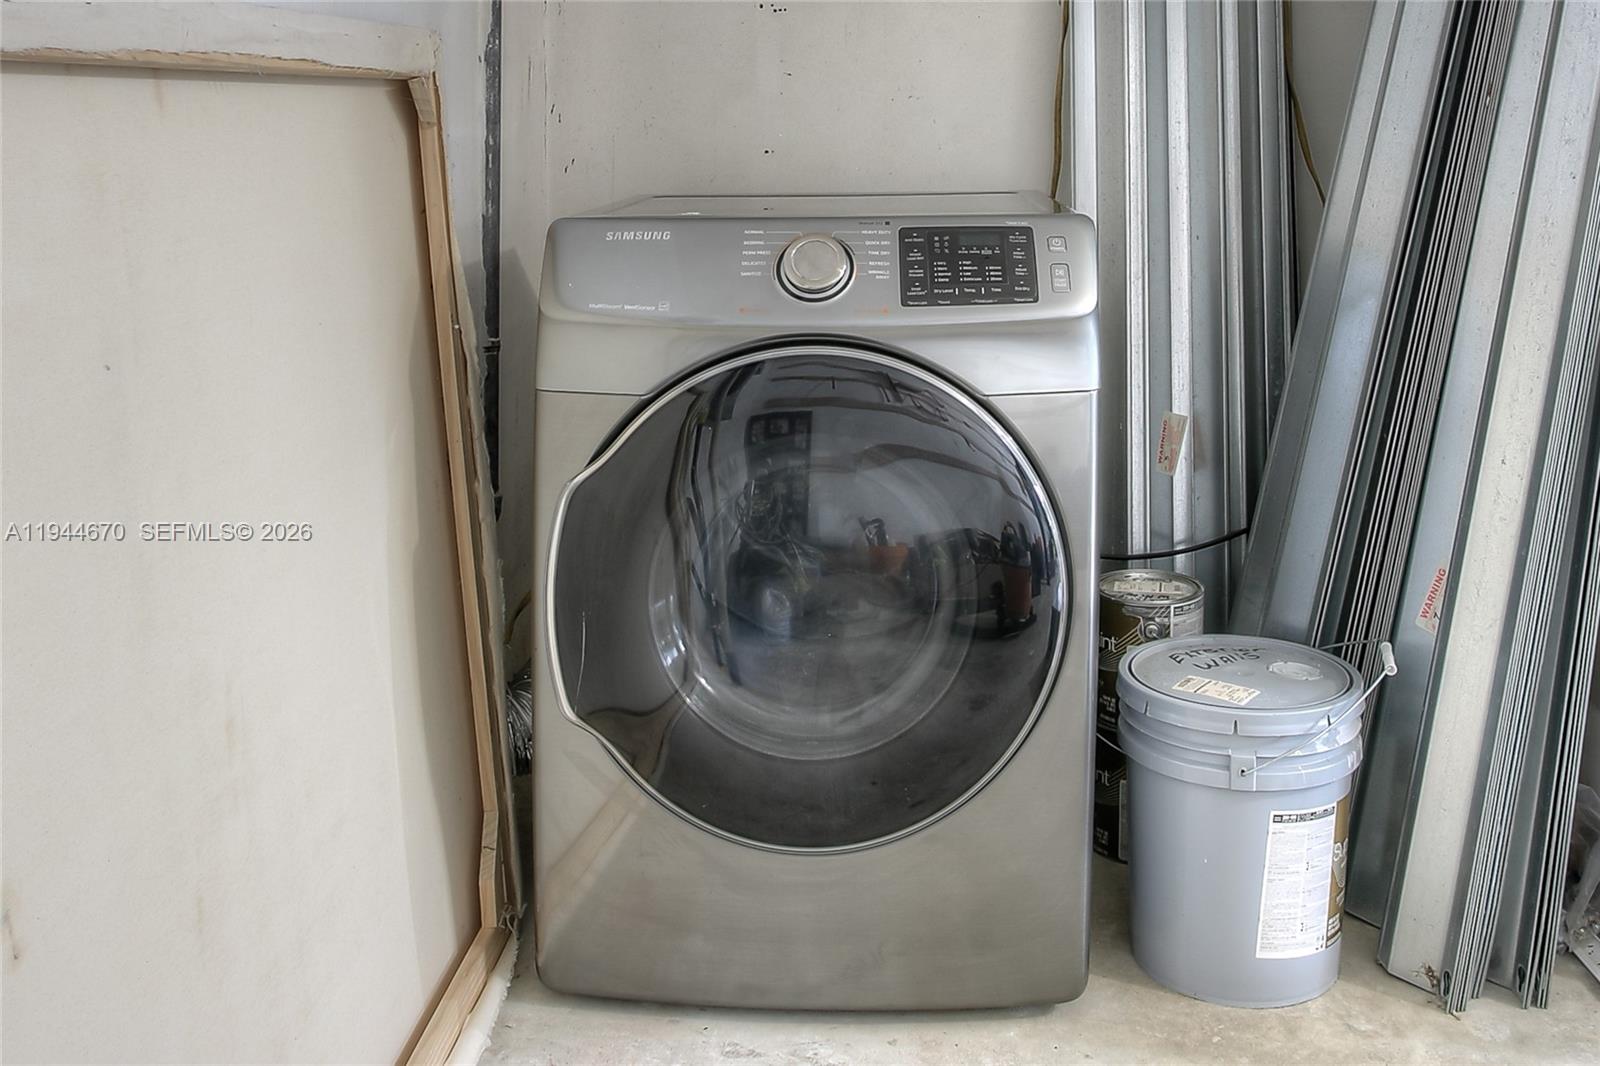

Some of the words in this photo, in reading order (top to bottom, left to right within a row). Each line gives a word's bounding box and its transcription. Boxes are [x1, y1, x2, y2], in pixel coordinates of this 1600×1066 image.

[605, 231, 671, 241] SAMSUNG
[1157, 419, 1168, 464] WARNING
[1420, 568, 1447, 619] WARNING
